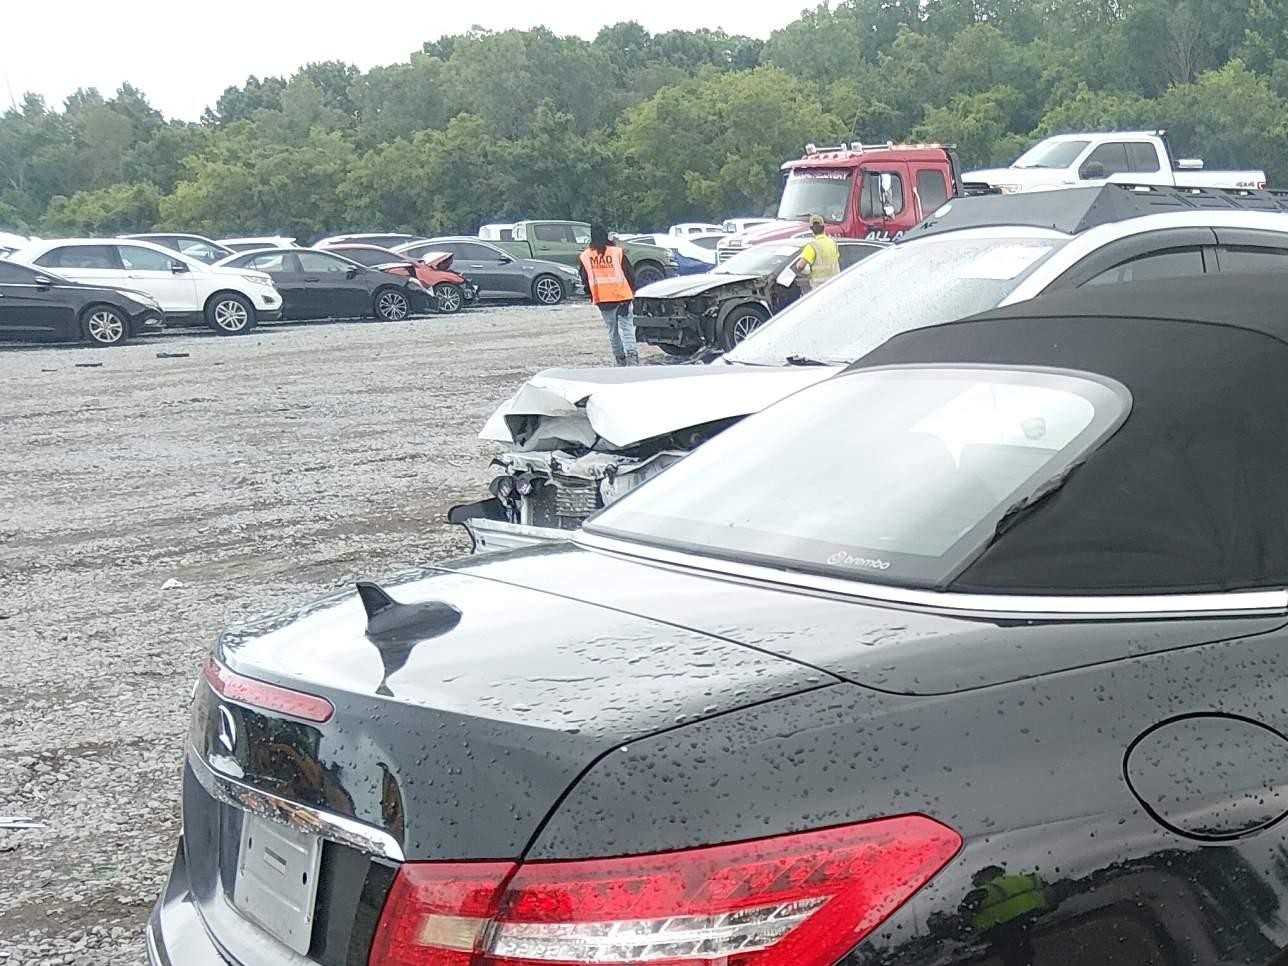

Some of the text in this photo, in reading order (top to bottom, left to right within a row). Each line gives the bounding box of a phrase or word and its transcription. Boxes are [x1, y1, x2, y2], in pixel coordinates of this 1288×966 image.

[865, 230, 891, 242] ALL
[589, 255, 613, 265] MAD
[843, 555, 891, 570] brembo
